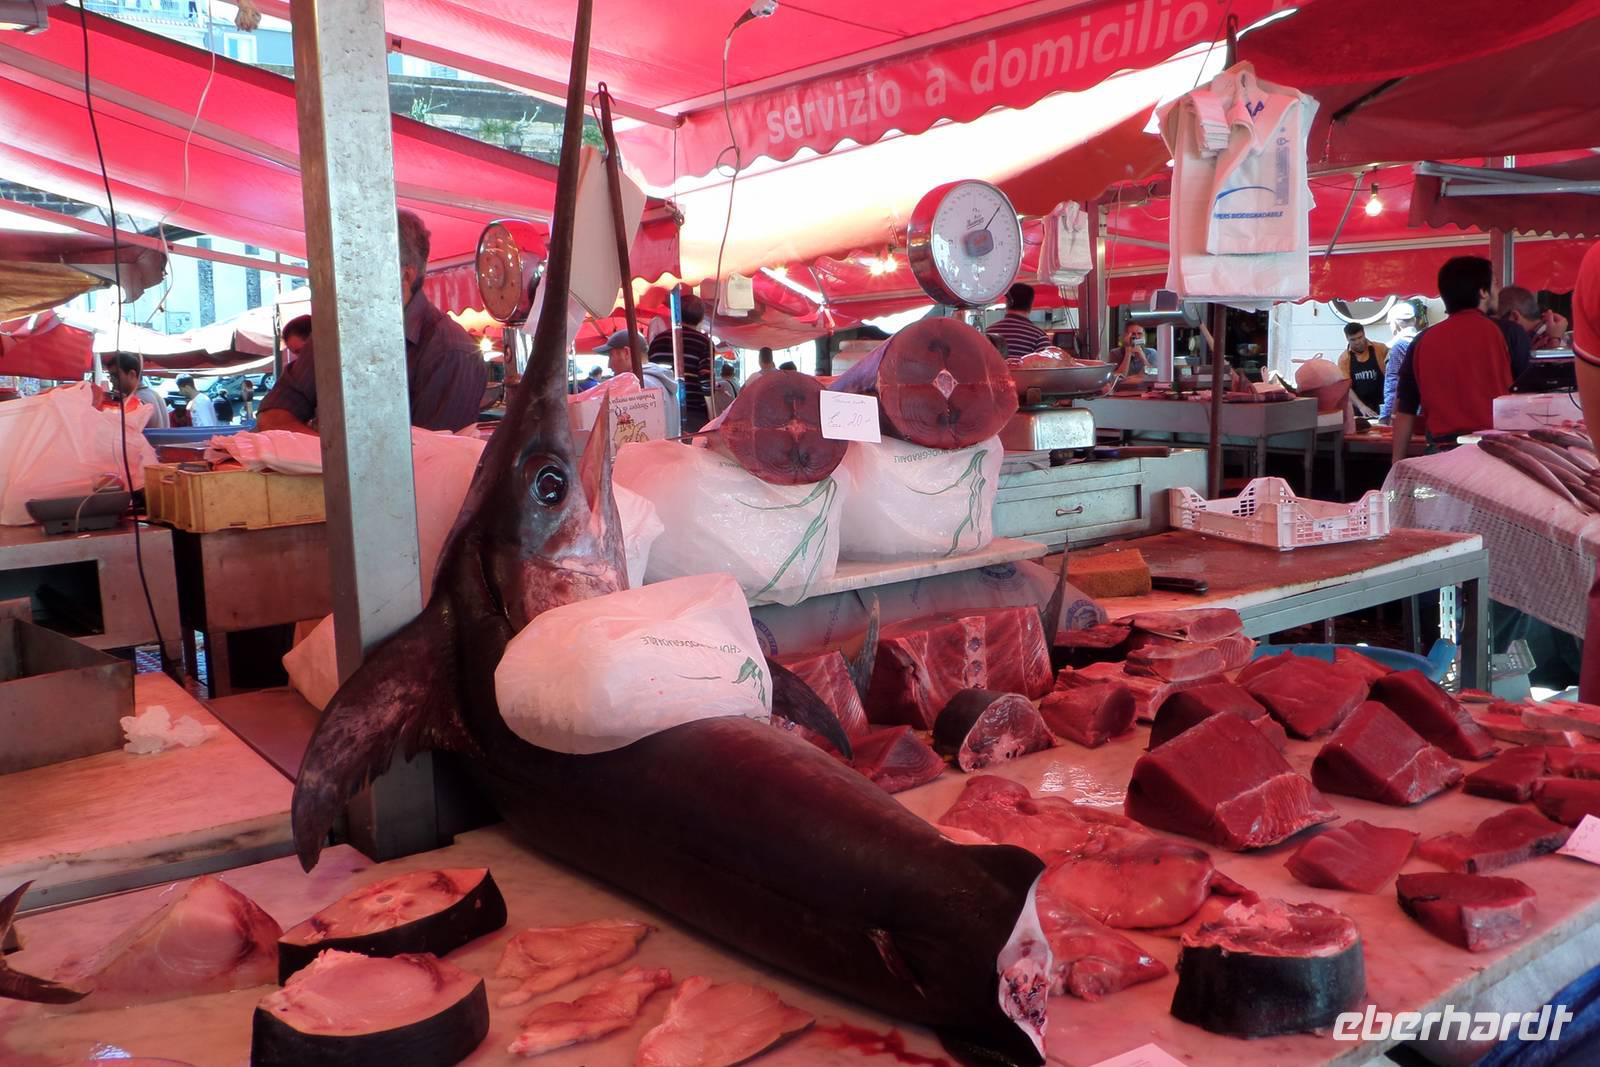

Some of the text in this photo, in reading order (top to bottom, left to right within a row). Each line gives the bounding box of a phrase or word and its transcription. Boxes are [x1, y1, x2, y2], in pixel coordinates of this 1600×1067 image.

[767, 0, 1209, 145] servizio a domicilio
